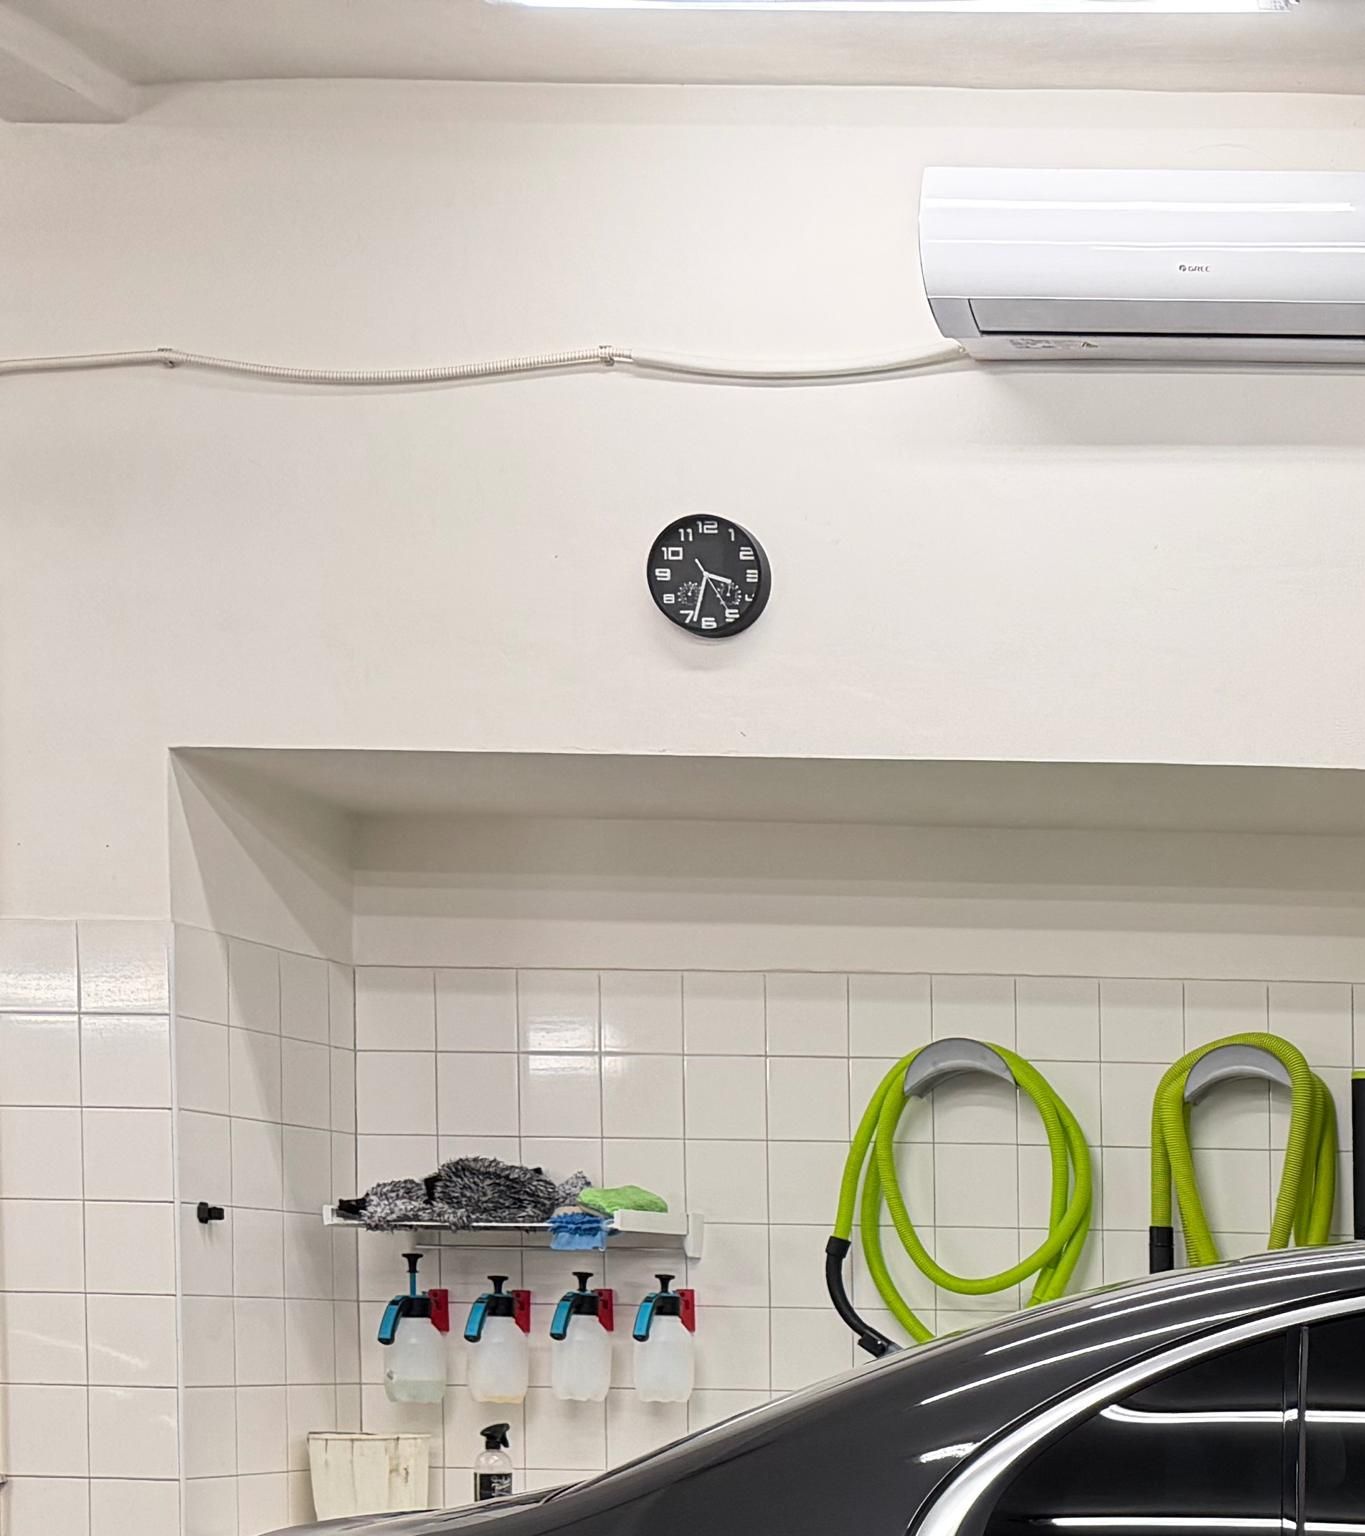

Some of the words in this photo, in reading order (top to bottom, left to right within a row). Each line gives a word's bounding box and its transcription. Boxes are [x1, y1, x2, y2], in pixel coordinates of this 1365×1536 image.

[696, 521, 718, 533] 12
[678, 528, 693, 541] 11
[728, 528, 735, 541] 1
[661, 547, 683, 560] 10
[739, 547, 754, 560] 2
[655, 568, 671, 581] 9
[746, 569, 758, 582] 3
[663, 594, 675, 604] 8
[679, 610, 694, 623] 7
[725, 608, 740, 622] 5
[701, 617, 717, 629] 6
